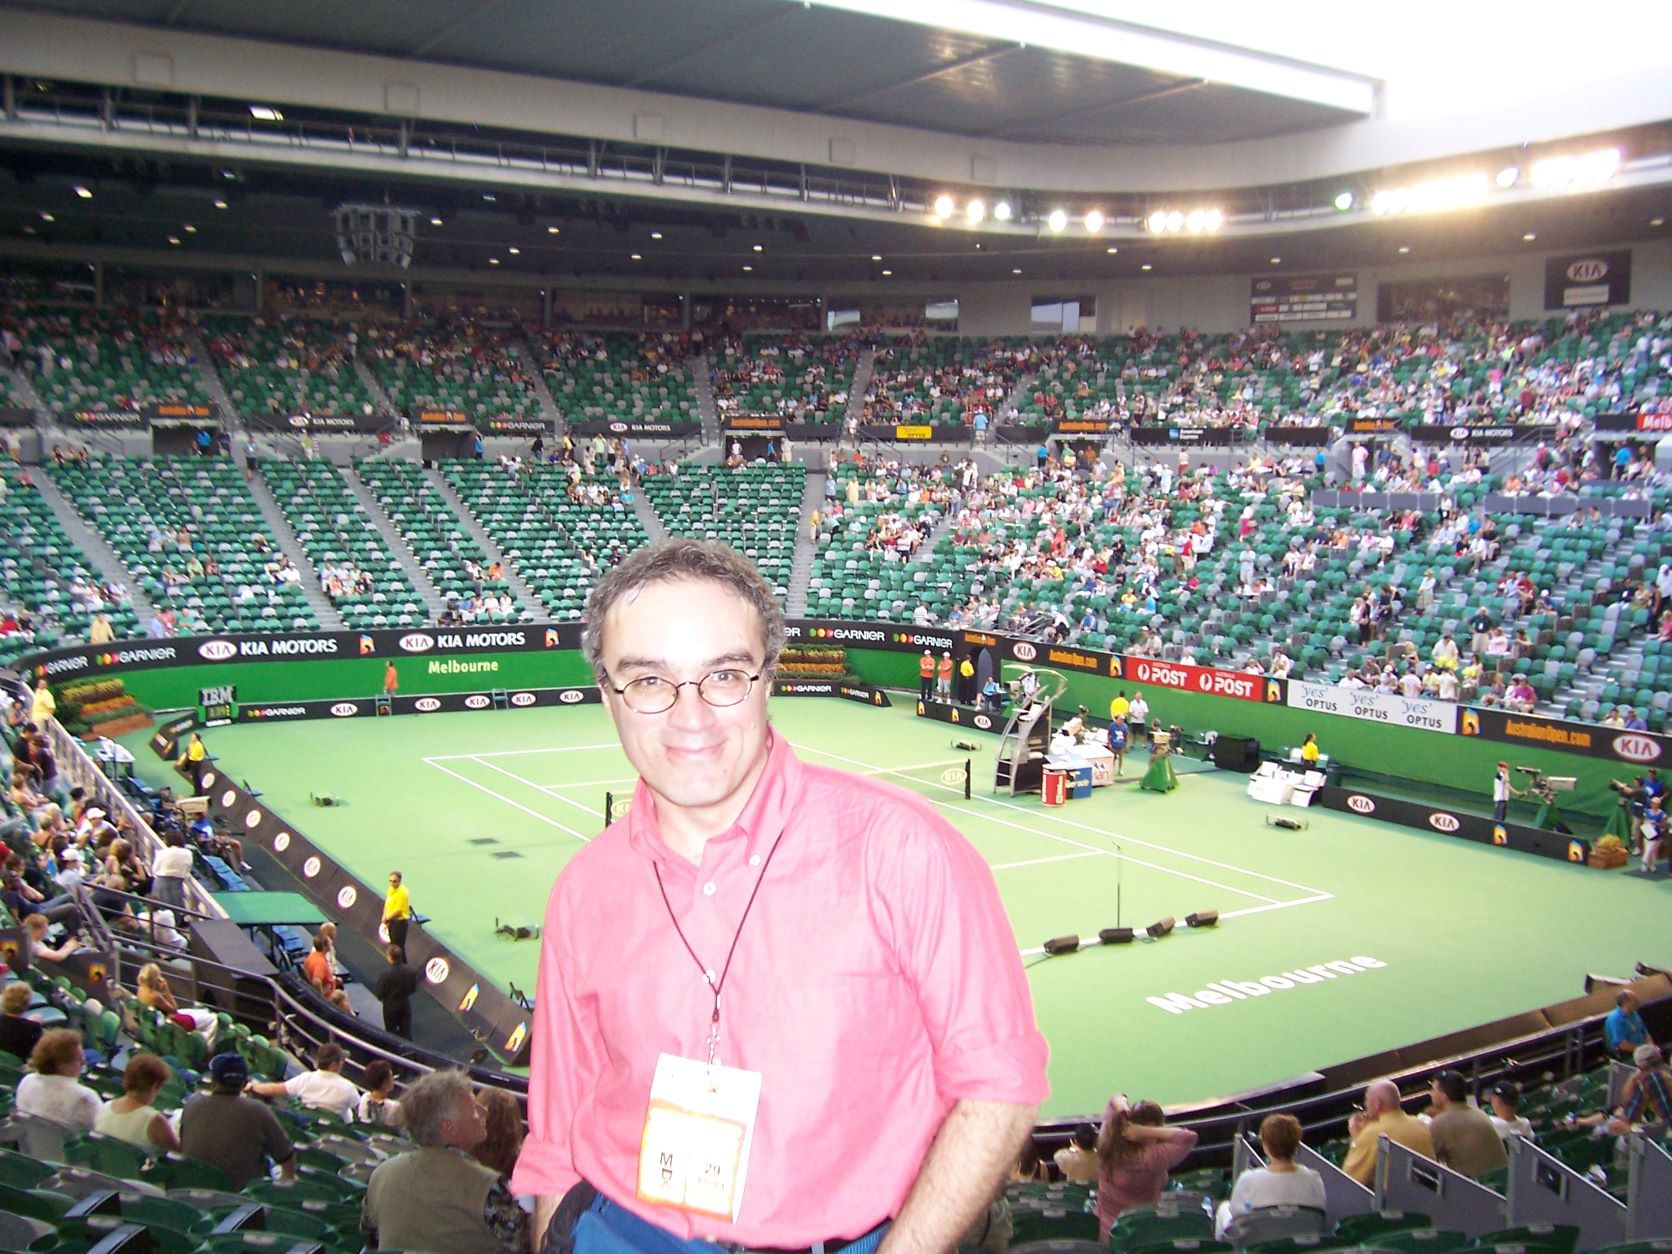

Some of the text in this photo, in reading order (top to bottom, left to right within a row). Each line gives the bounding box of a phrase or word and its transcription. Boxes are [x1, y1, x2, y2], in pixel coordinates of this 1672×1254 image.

[1572, 262, 1601, 279] KIA
[437, 632, 526, 648] KIA MOTORS
[833, 628, 885, 642] GARNIER
[913, 634, 953, 649] GARNIER
[205, 643, 232, 657] KIA
[240, 639, 338, 656] KIA MOTORS
[404, 637, 430, 649] KIA
[119, 647, 177, 663] GARNIER
[1016, 645, 1034, 658] KIA
[428, 660, 499, 674] Melbourne
[1151, 667, 1188, 686] POST
[796, 685, 832, 693] GARNIER
[1214, 677, 1254, 697] POST
[201, 686, 234, 706] IBM
[469, 697, 488, 706] KIA
[515, 694, 533, 704] KIA
[563, 692, 580, 701] KIA
[334, 703, 354, 713] KIA
[418, 698, 439, 709] KIA
[1305, 698, 1338, 711] OPTUS
[1354, 706, 1388, 720] OPTUS
[1406, 714, 1442, 728] OPTUS
[1620, 738, 1653, 757] KIA
[1351, 798, 1371, 811] KIA
[1433, 815, 1456, 829] KIA
[428, 959, 446, 980] KIA
[1145, 955, 1388, 1015] Melbourne
